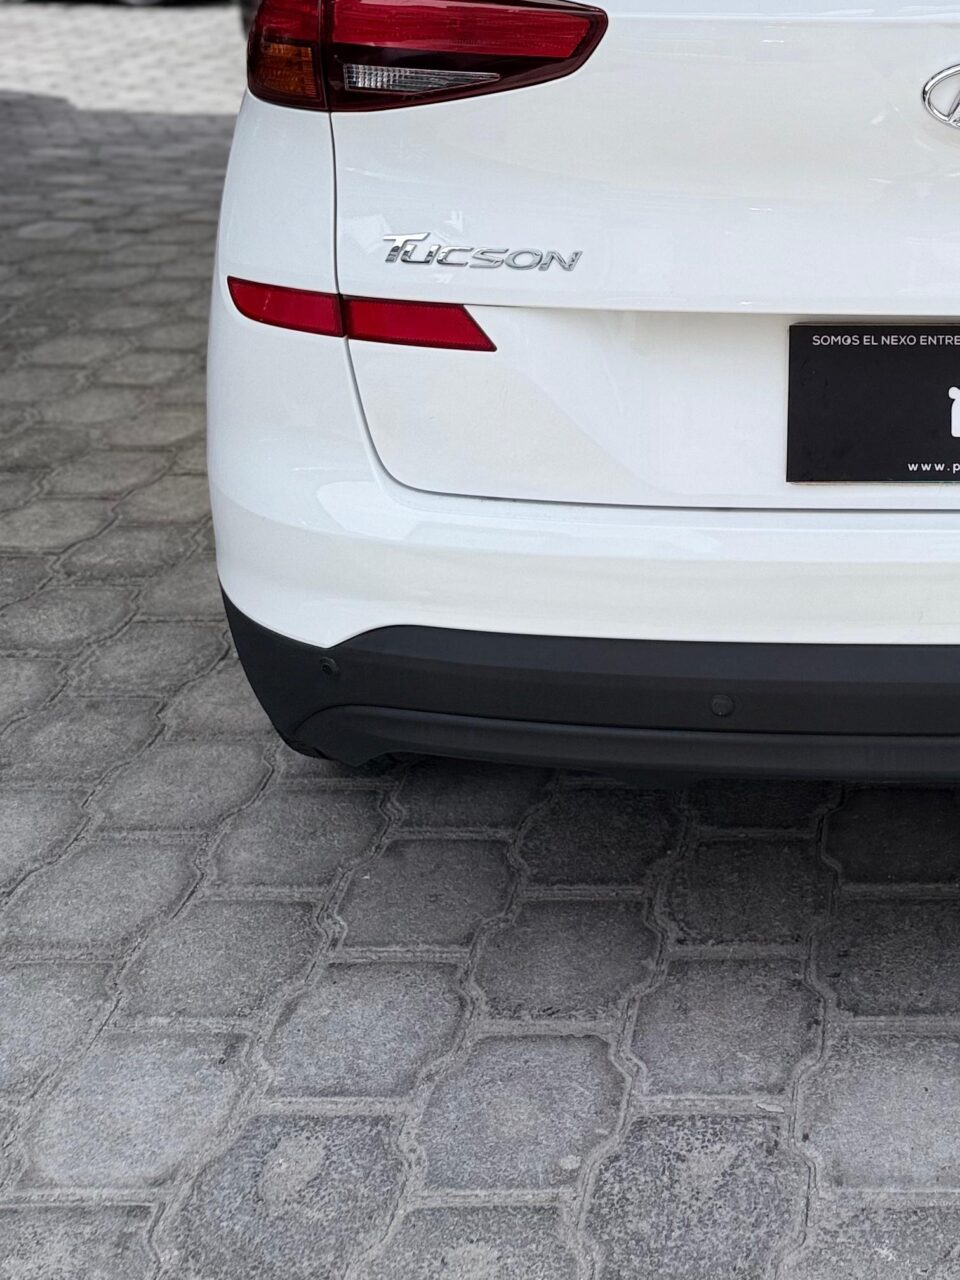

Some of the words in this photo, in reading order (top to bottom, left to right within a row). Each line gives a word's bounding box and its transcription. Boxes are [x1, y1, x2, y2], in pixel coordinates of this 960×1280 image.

[383, 231, 584, 272] TUCSON
[812, 334, 860, 346] SOMOS
[863, 334, 878, 346] EL
[881, 334, 917, 346] NEXO
